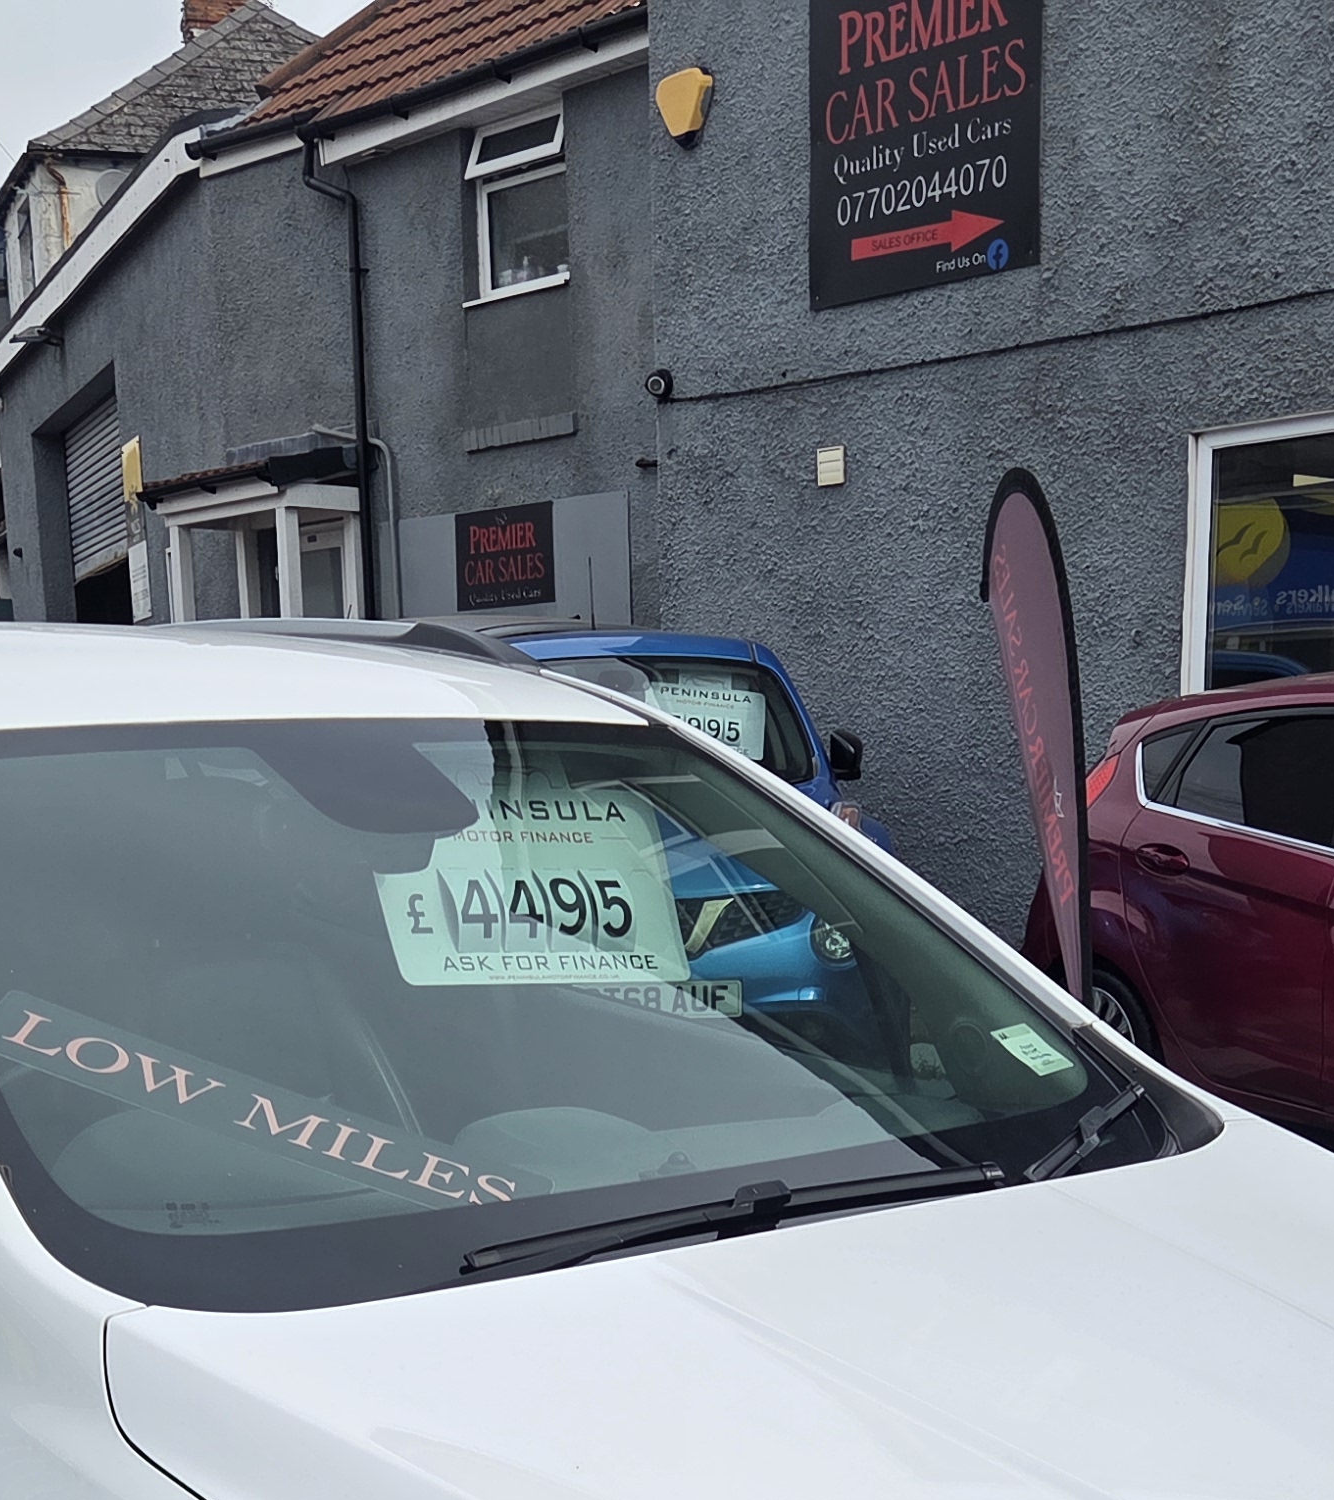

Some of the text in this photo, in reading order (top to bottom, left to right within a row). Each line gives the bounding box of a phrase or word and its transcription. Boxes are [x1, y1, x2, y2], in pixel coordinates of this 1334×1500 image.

[838, 0, 1009, 76] PREMIER
[825, 38, 1026, 145] CAR SALES
[833, 117, 1012, 185] Quality Used Cars
[836, 155, 1008, 227] 07702044070
[871, 229, 939, 252] SALES OFFICE
[935, 257, 956, 274] Find
[957, 256, 971, 269] Us
[972, 252, 987, 266] On
[469, 521, 537, 555] PREMIER
[464, 553, 546, 586] CAR SALES
[660, 686, 752, 704] PENINSULA
[672, 714, 741, 742] 995
[473, 799, 626, 822] INSULA
[453, 830, 594, 844] MOTOR FINANCE
[406, 878, 633, 939] £ 4495
[443, 954, 659, 972] ASK FOR FINANCE
[671, 985, 729, 1012] AUF
[2, 1009, 517, 1206] LOW MILES
